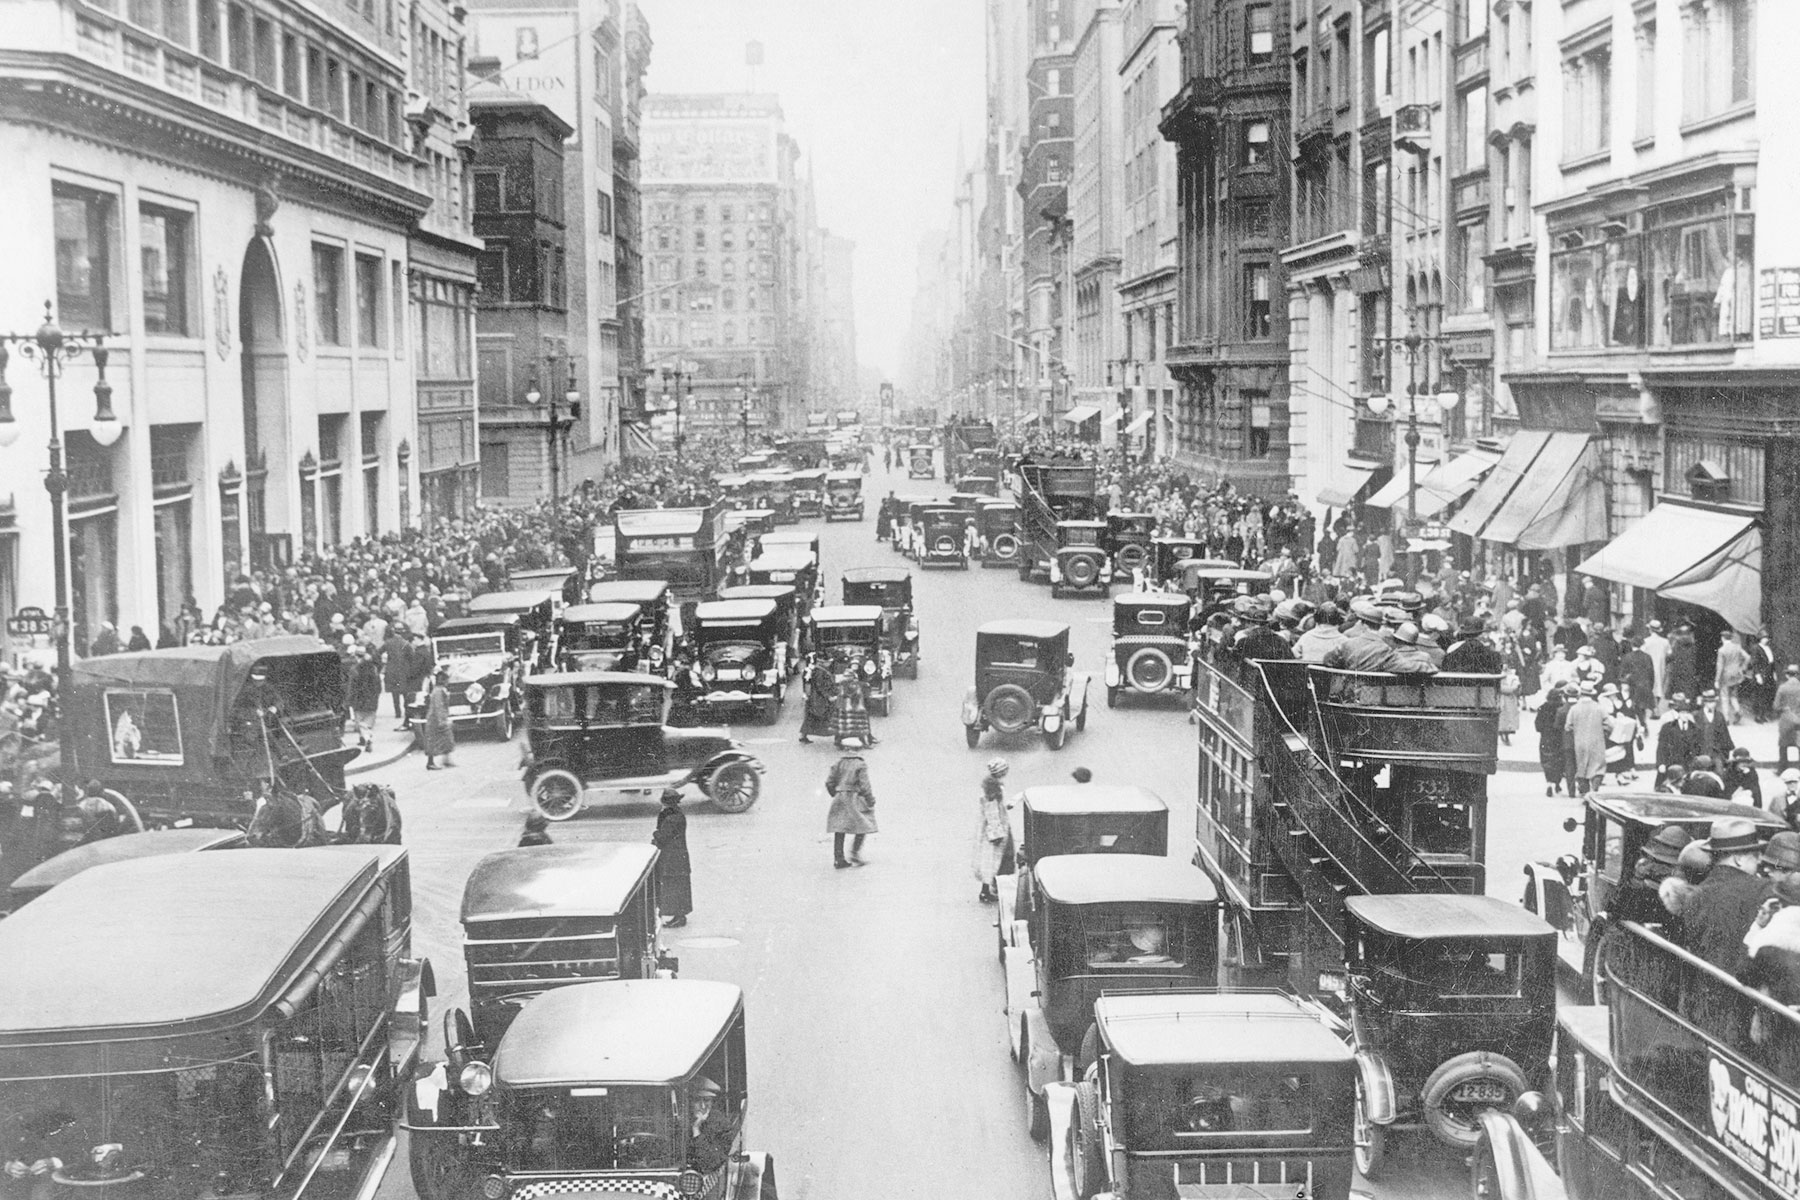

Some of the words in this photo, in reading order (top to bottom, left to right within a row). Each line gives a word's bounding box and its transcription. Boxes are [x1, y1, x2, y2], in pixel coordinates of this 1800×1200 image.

[20, 620, 37, 632] 38
[1728, 1084, 1769, 1157] HOME
[1769, 1114, 1800, 1177] SHO
